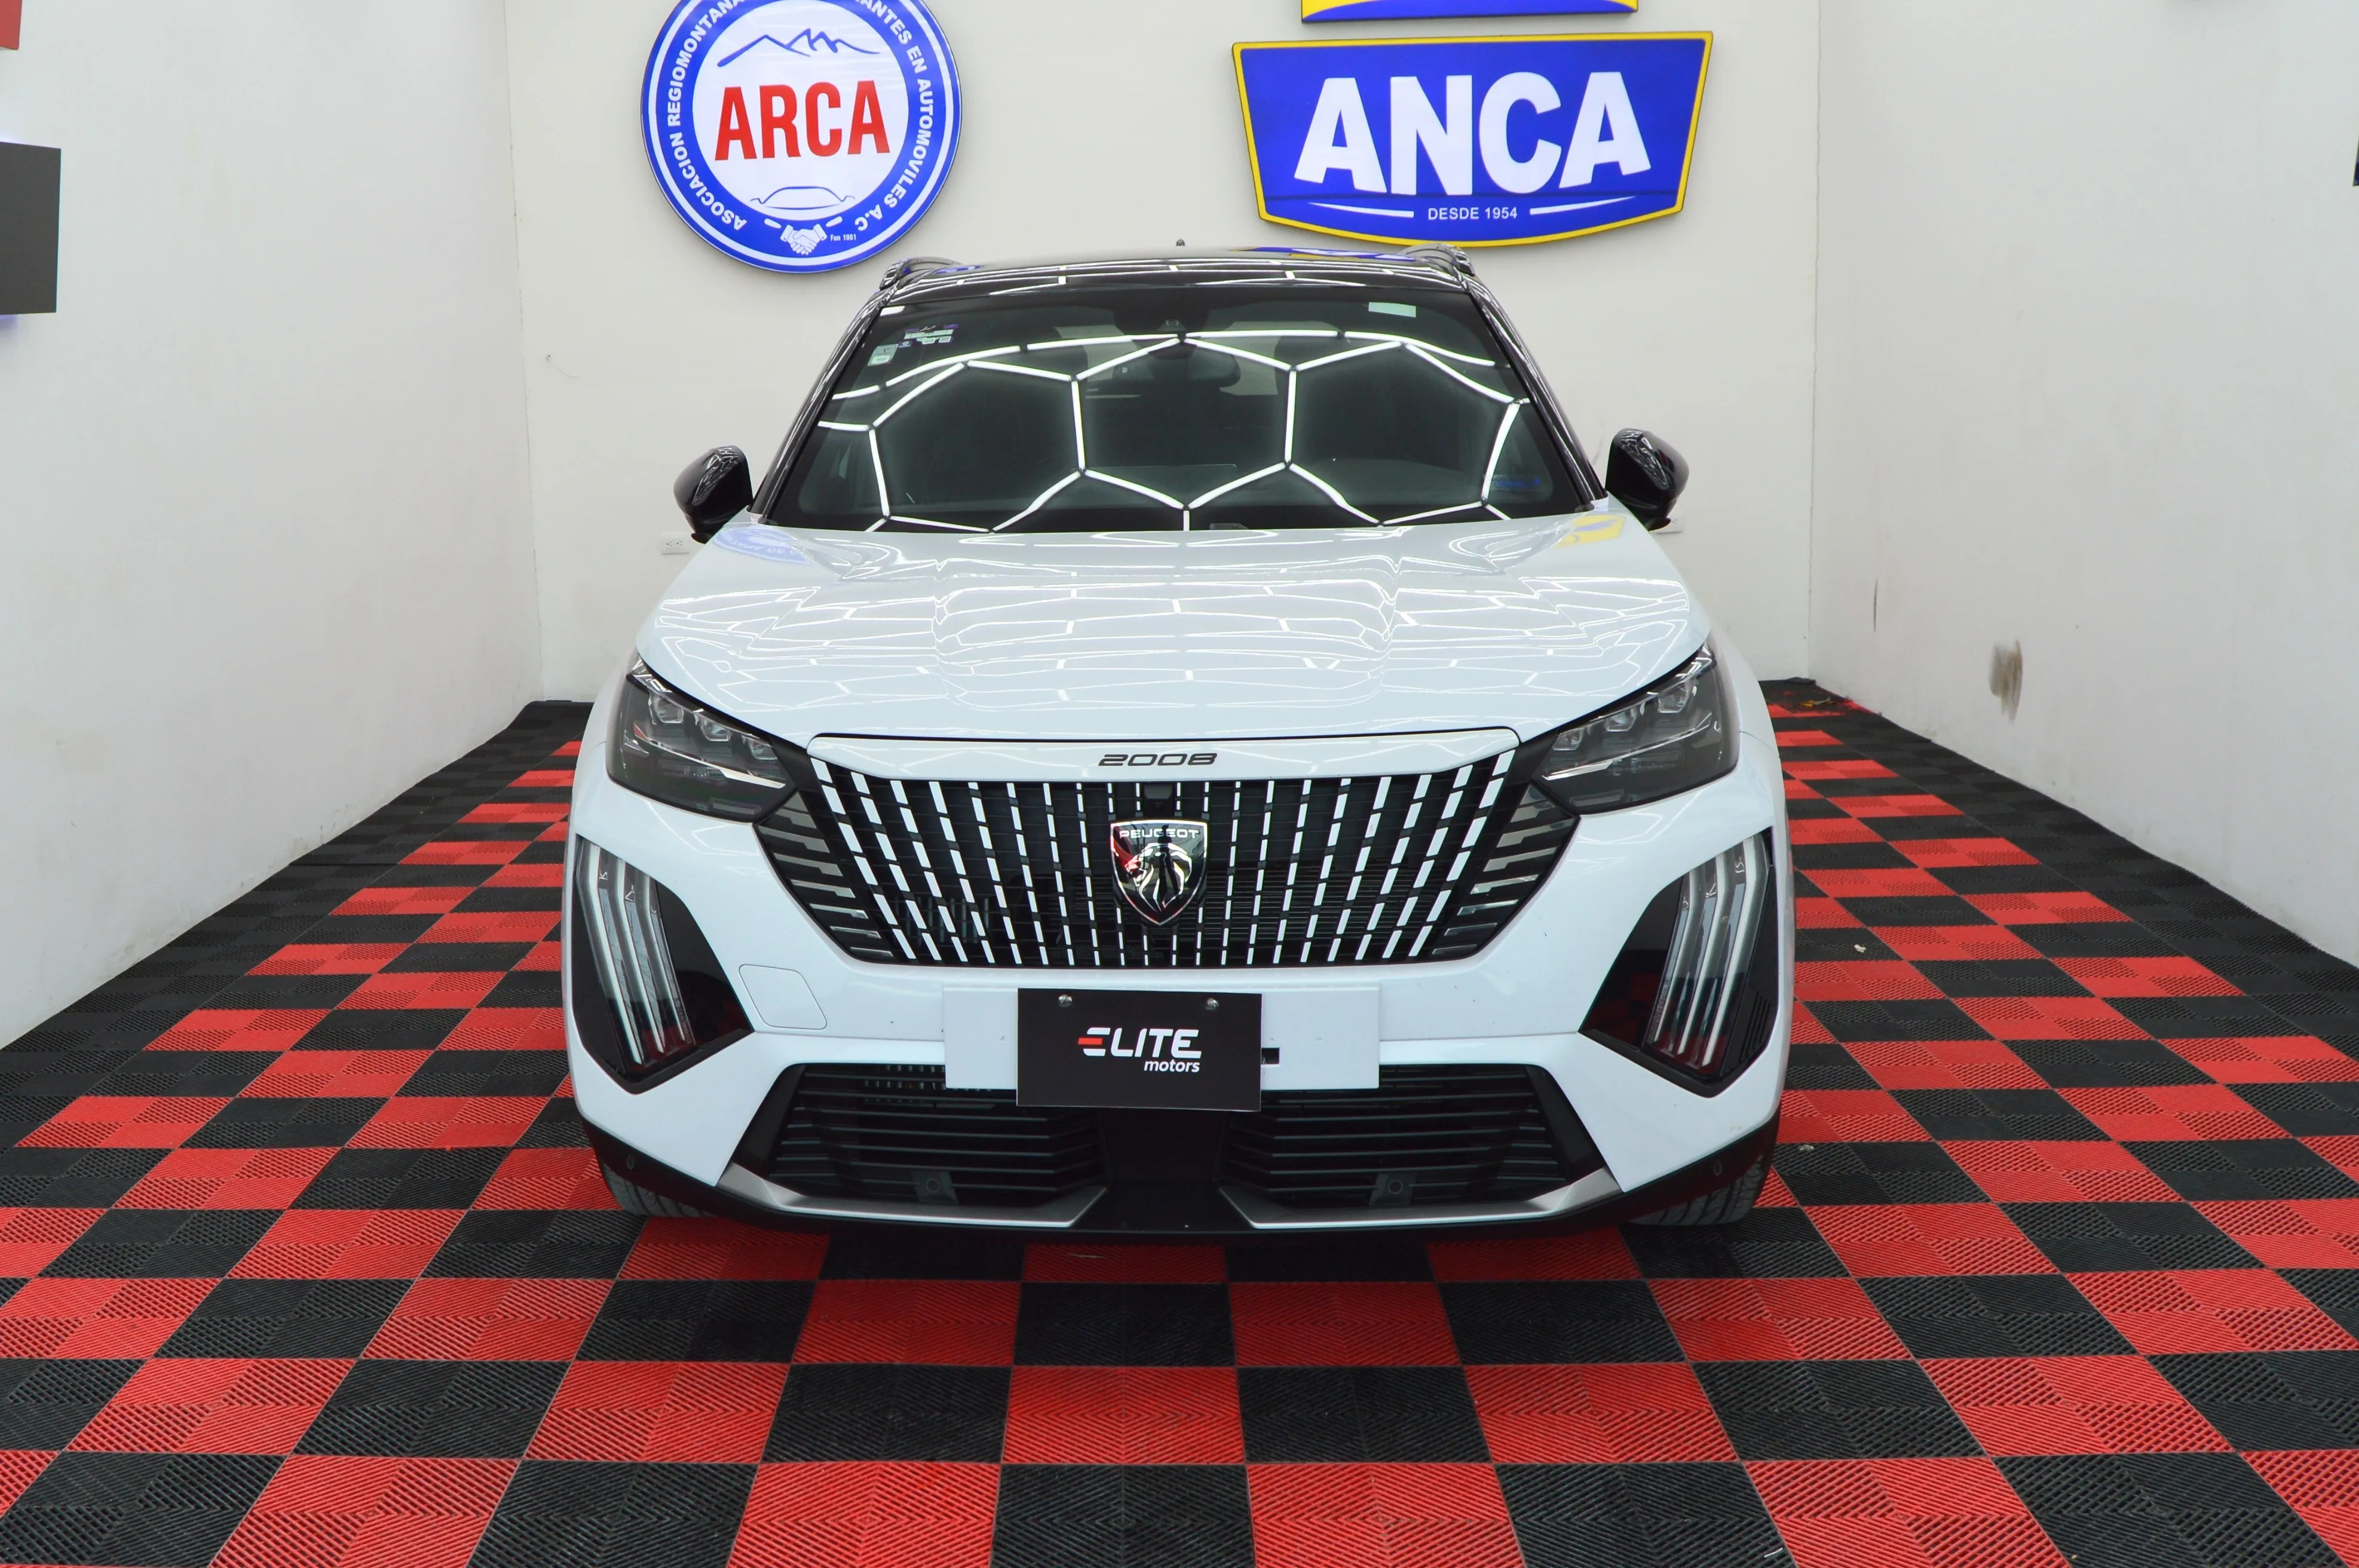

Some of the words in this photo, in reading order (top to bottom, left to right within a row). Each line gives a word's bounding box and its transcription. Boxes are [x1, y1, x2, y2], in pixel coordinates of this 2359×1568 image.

[856, 0, 912, 44] ANTES
[906, 45, 927, 74] EN
[715, 80, 890, 161] ARCA
[1294, 72, 1652, 196] ANCA
[884, 78, 933, 208] AUTOMOVILES
[669, 132, 747, 231] ASOCIACION
[1427, 207, 1479, 220] DESDE
[1485, 206, 1518, 220] 1954
[1098, 753, 1218, 767] 2008
[1119, 828, 1200, 839] PEUGEOT
[1078, 1027, 1202, 1059] ELITE
[1144, 1058, 1200, 1073] motors
